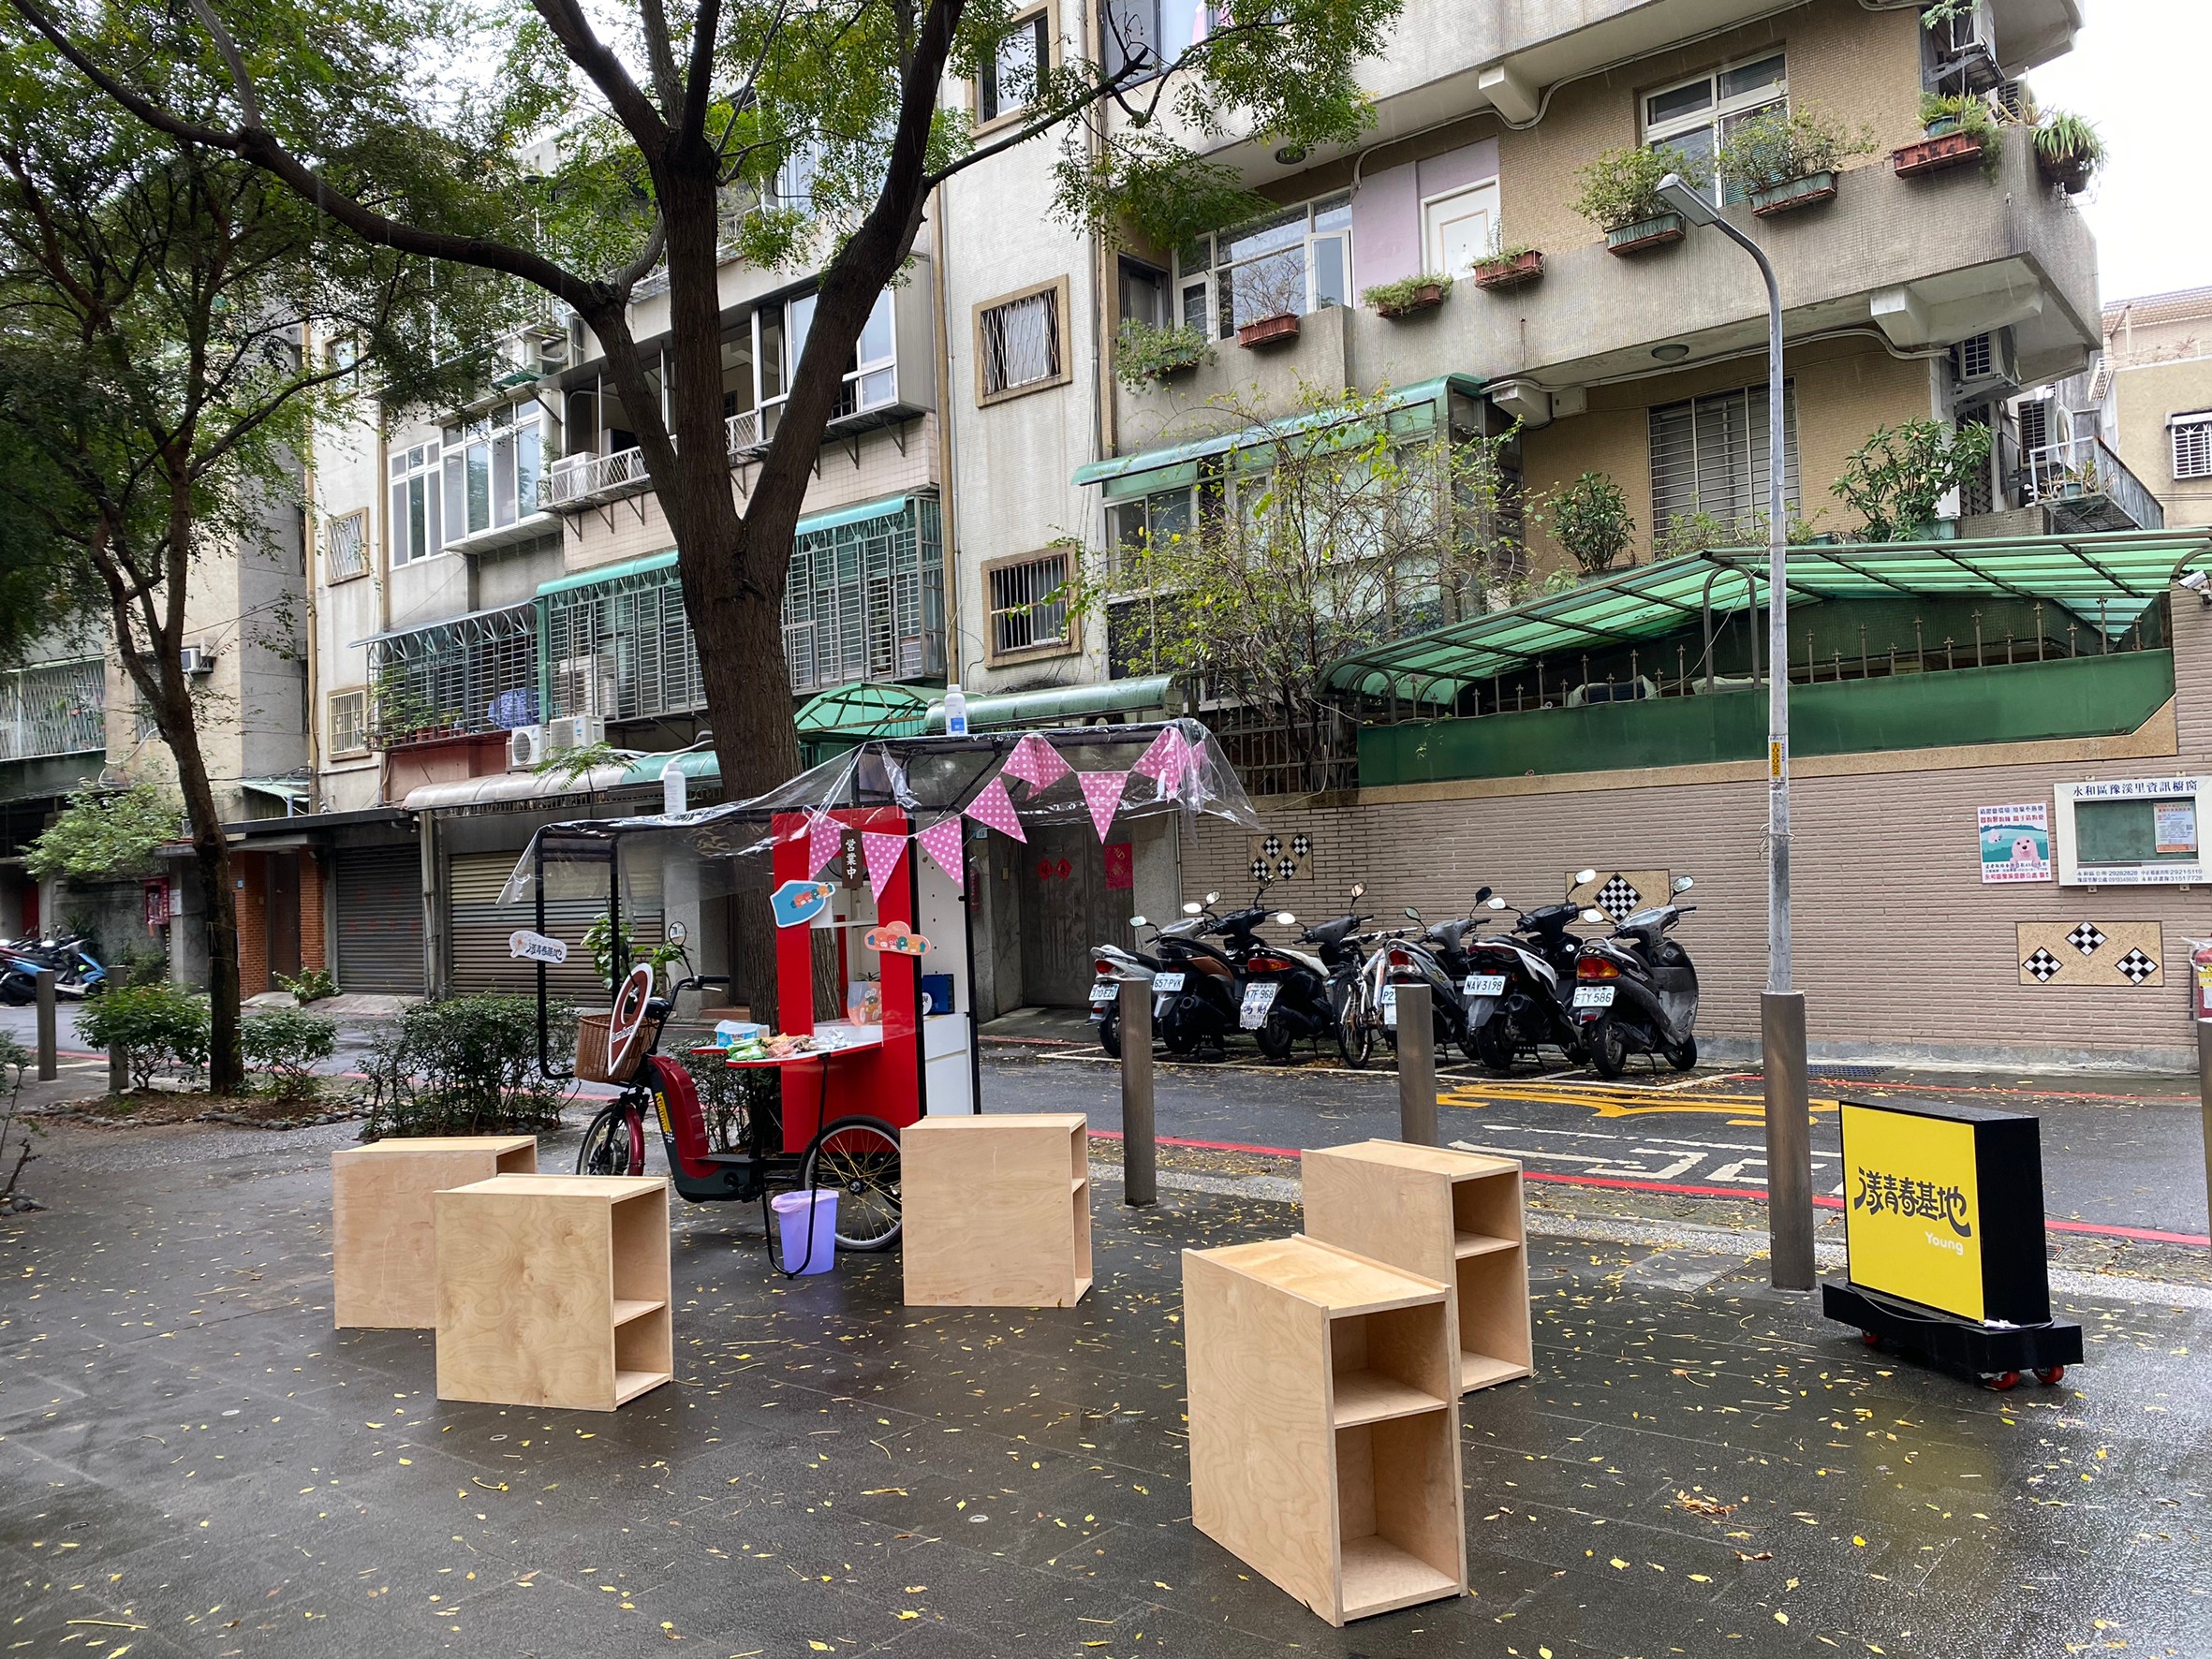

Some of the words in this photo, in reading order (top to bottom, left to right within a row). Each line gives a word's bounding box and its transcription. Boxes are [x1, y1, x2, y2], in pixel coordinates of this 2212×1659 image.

[2072, 780, 2198, 797] 永和區豫溪里資訊櫥窗
[1853, 1166, 1972, 1238] 漾青春基地
[1924, 1231, 1964, 1255] Young
